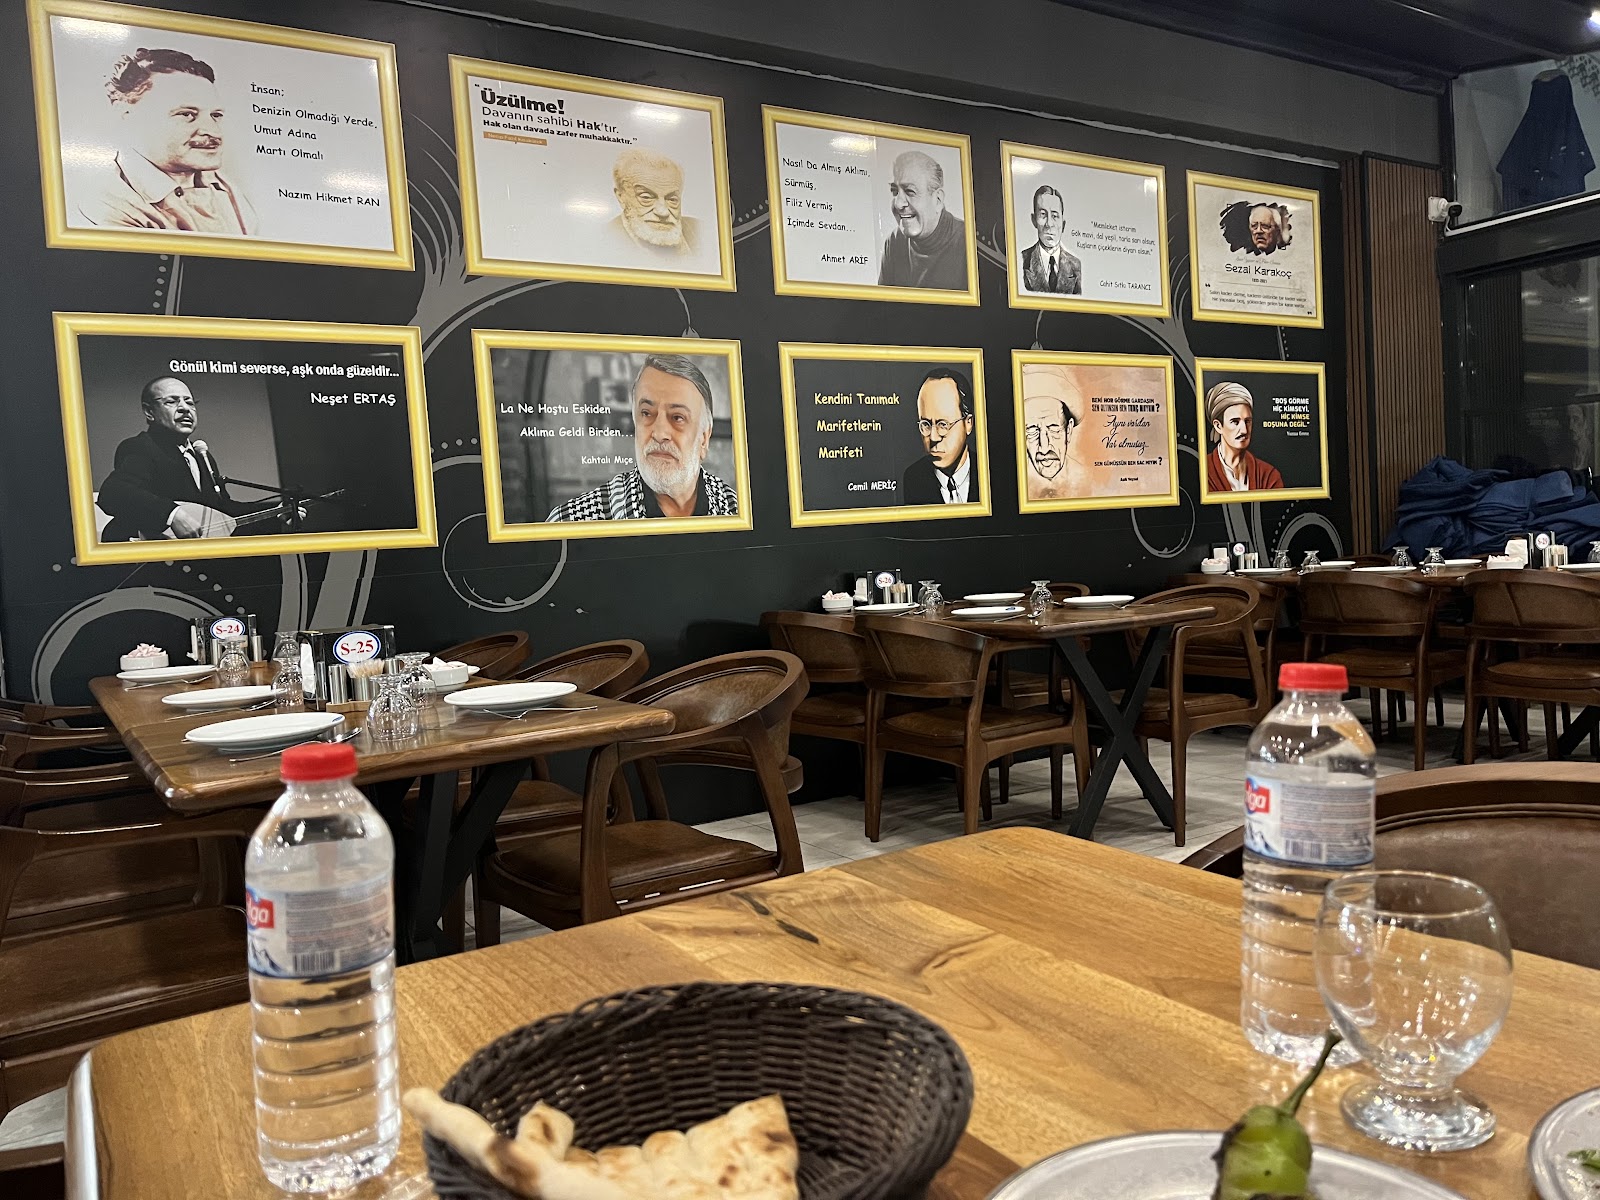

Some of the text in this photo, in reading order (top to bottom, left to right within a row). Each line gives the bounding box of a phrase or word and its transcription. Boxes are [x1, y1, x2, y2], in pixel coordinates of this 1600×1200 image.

[251, 82, 285, 97] İnsan;
[253, 104, 291, 117] Denizin
[296, 110, 340, 125] Olmadığı
[482, 107, 534, 122] Davanın
[537, 115, 573, 128] sahibi
[254, 125, 317, 140] Umut Adına
[483, 120, 501, 128] Hak
[503, 123, 521, 131] olan
[524, 125, 555, 135] davada
[557, 130, 578, 138] zafer
[257, 145, 324, 160] Martı Olmalı
[783, 158, 803, 168] Nasıl
[807, 161, 818, 170] Da
[821, 163, 841, 174] Almış
[785, 179, 817, 190] Sürmüş,
[279, 189, 380, 207] Nazım Hikmet RAN
[786, 198, 833, 212] Filiz Vermiş
[787, 216, 855, 232] İçimde Sevdan...
[821, 254, 869, 265] Ahmet ARİF
[1225, 264, 1292, 279] Sezai Karakoç
[1128, 283, 1151, 291] TARANCI
[170, 360, 400, 379] Gönül kimi severse, aşk onda güzeldir...
[311, 393, 396, 406] Neşet ERTAŞ
[815, 393, 900, 405] Kendini Tanımak
[501, 403, 611, 416] La Ne Hoştu Eskiden
[1273, 405, 1283, 413] HİÇ
[1281, 413, 1291, 421] HİÇ
[520, 427, 633, 437] Aklıma Geldi Birden...
[817, 420, 882, 432] Marifetlerin
[819, 446, 863, 459] Marifeti
[582, 456, 611, 464] Kahtalı
[848, 480, 897, 491] Cemil MERİÇ
[216, 625, 240, 636] S-24
[341, 640, 374, 656] S-25
